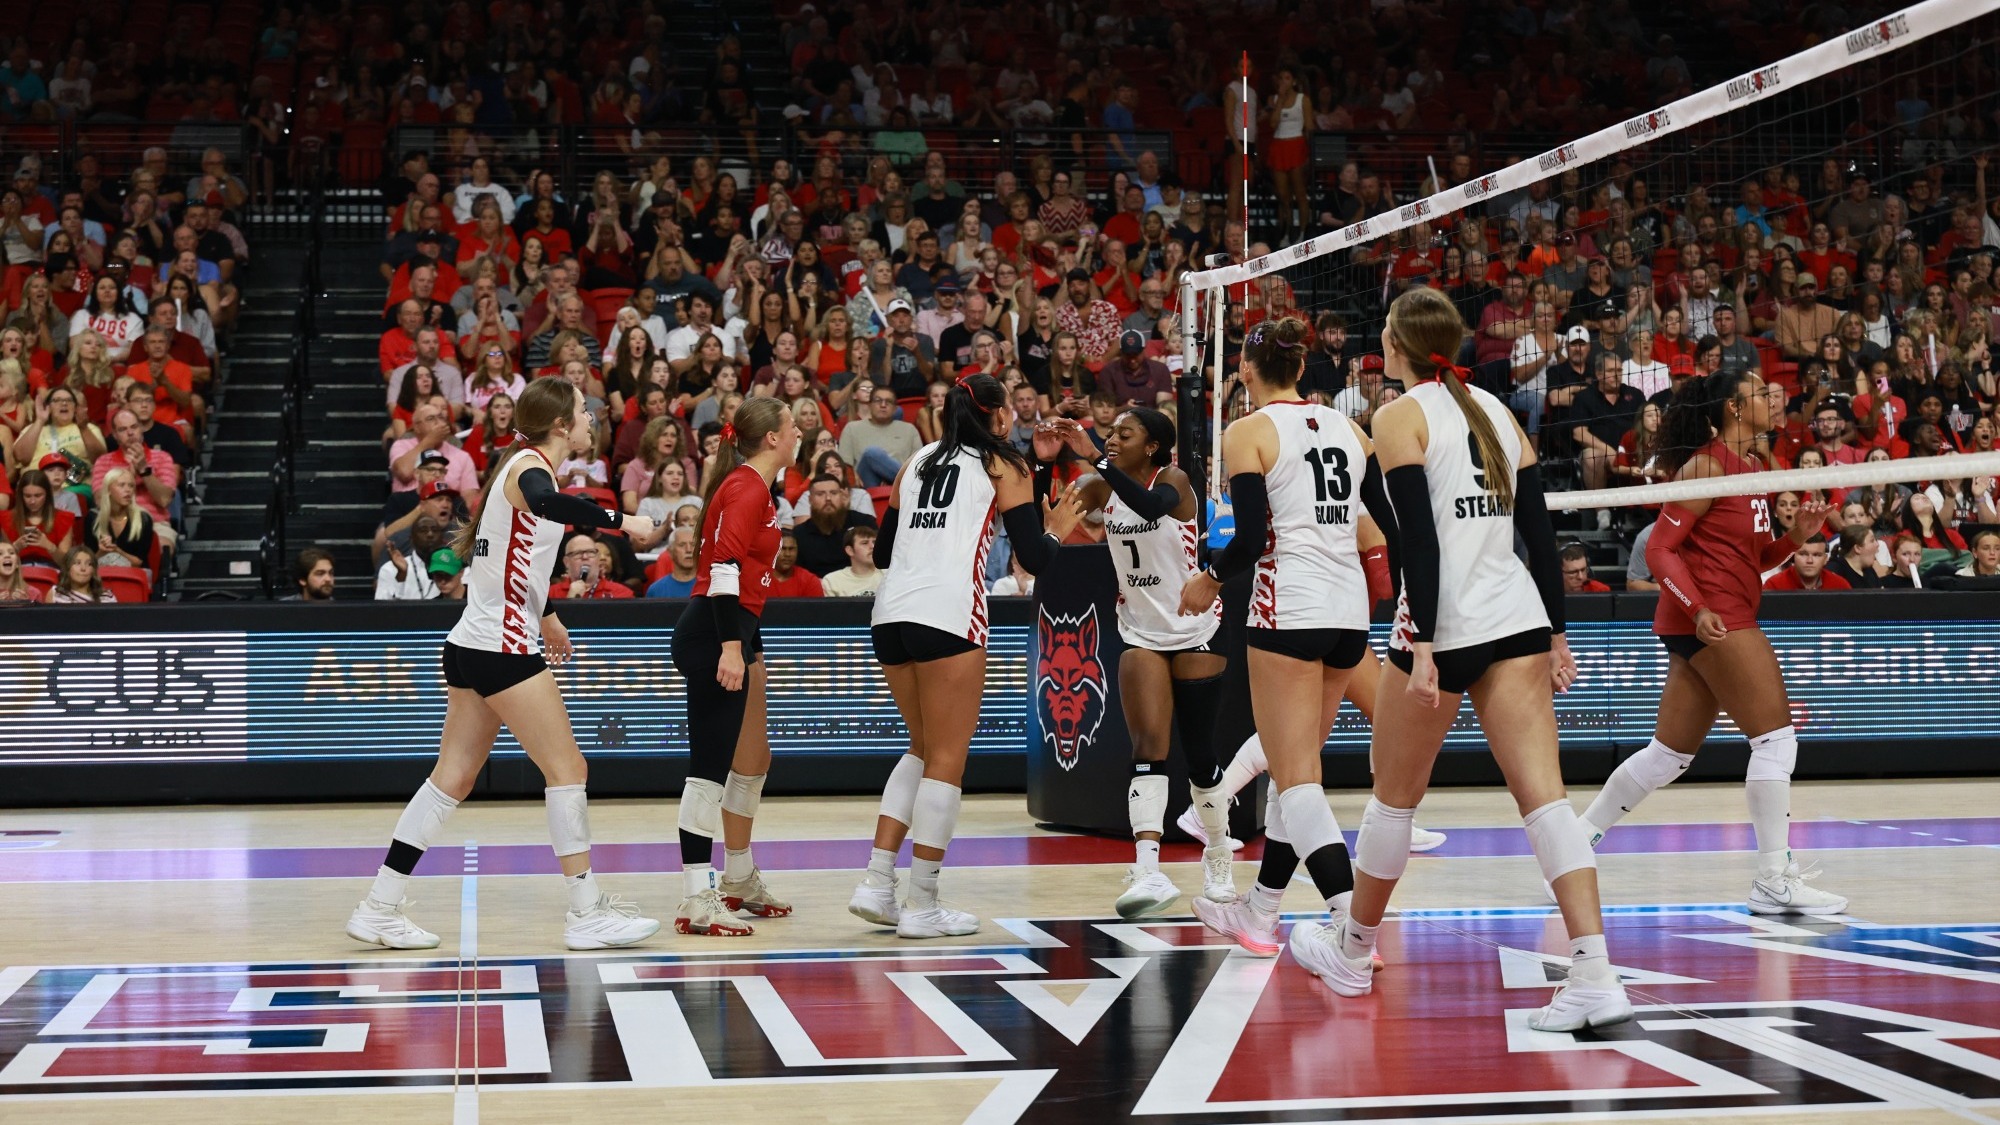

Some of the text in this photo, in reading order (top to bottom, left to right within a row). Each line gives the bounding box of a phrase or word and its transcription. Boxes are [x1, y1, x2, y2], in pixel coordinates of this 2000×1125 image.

[1845, 13, 1909, 56] ARKANSAS STATE
[1727, 66, 1780, 102] ARKANSAS STATE
[1625, 115, 1651, 139] ARKANSAS
[1539, 149, 1561, 171] ARKANSAS
[917, 463, 960, 509] 10
[1304, 447, 1352, 502] 13
[909, 511, 947, 529] JOSKA
[1106, 520, 1161, 535] Arkansas
[1315, 505, 1349, 524] GLUNZ
[1750, 499, 1771, 533] 23
[1122, 540, 1140, 569] 7
[1126, 573, 1161, 587] State
[1663, 577, 1692, 607] RAZORBACKS
[303, 644, 420, 705] Ask
